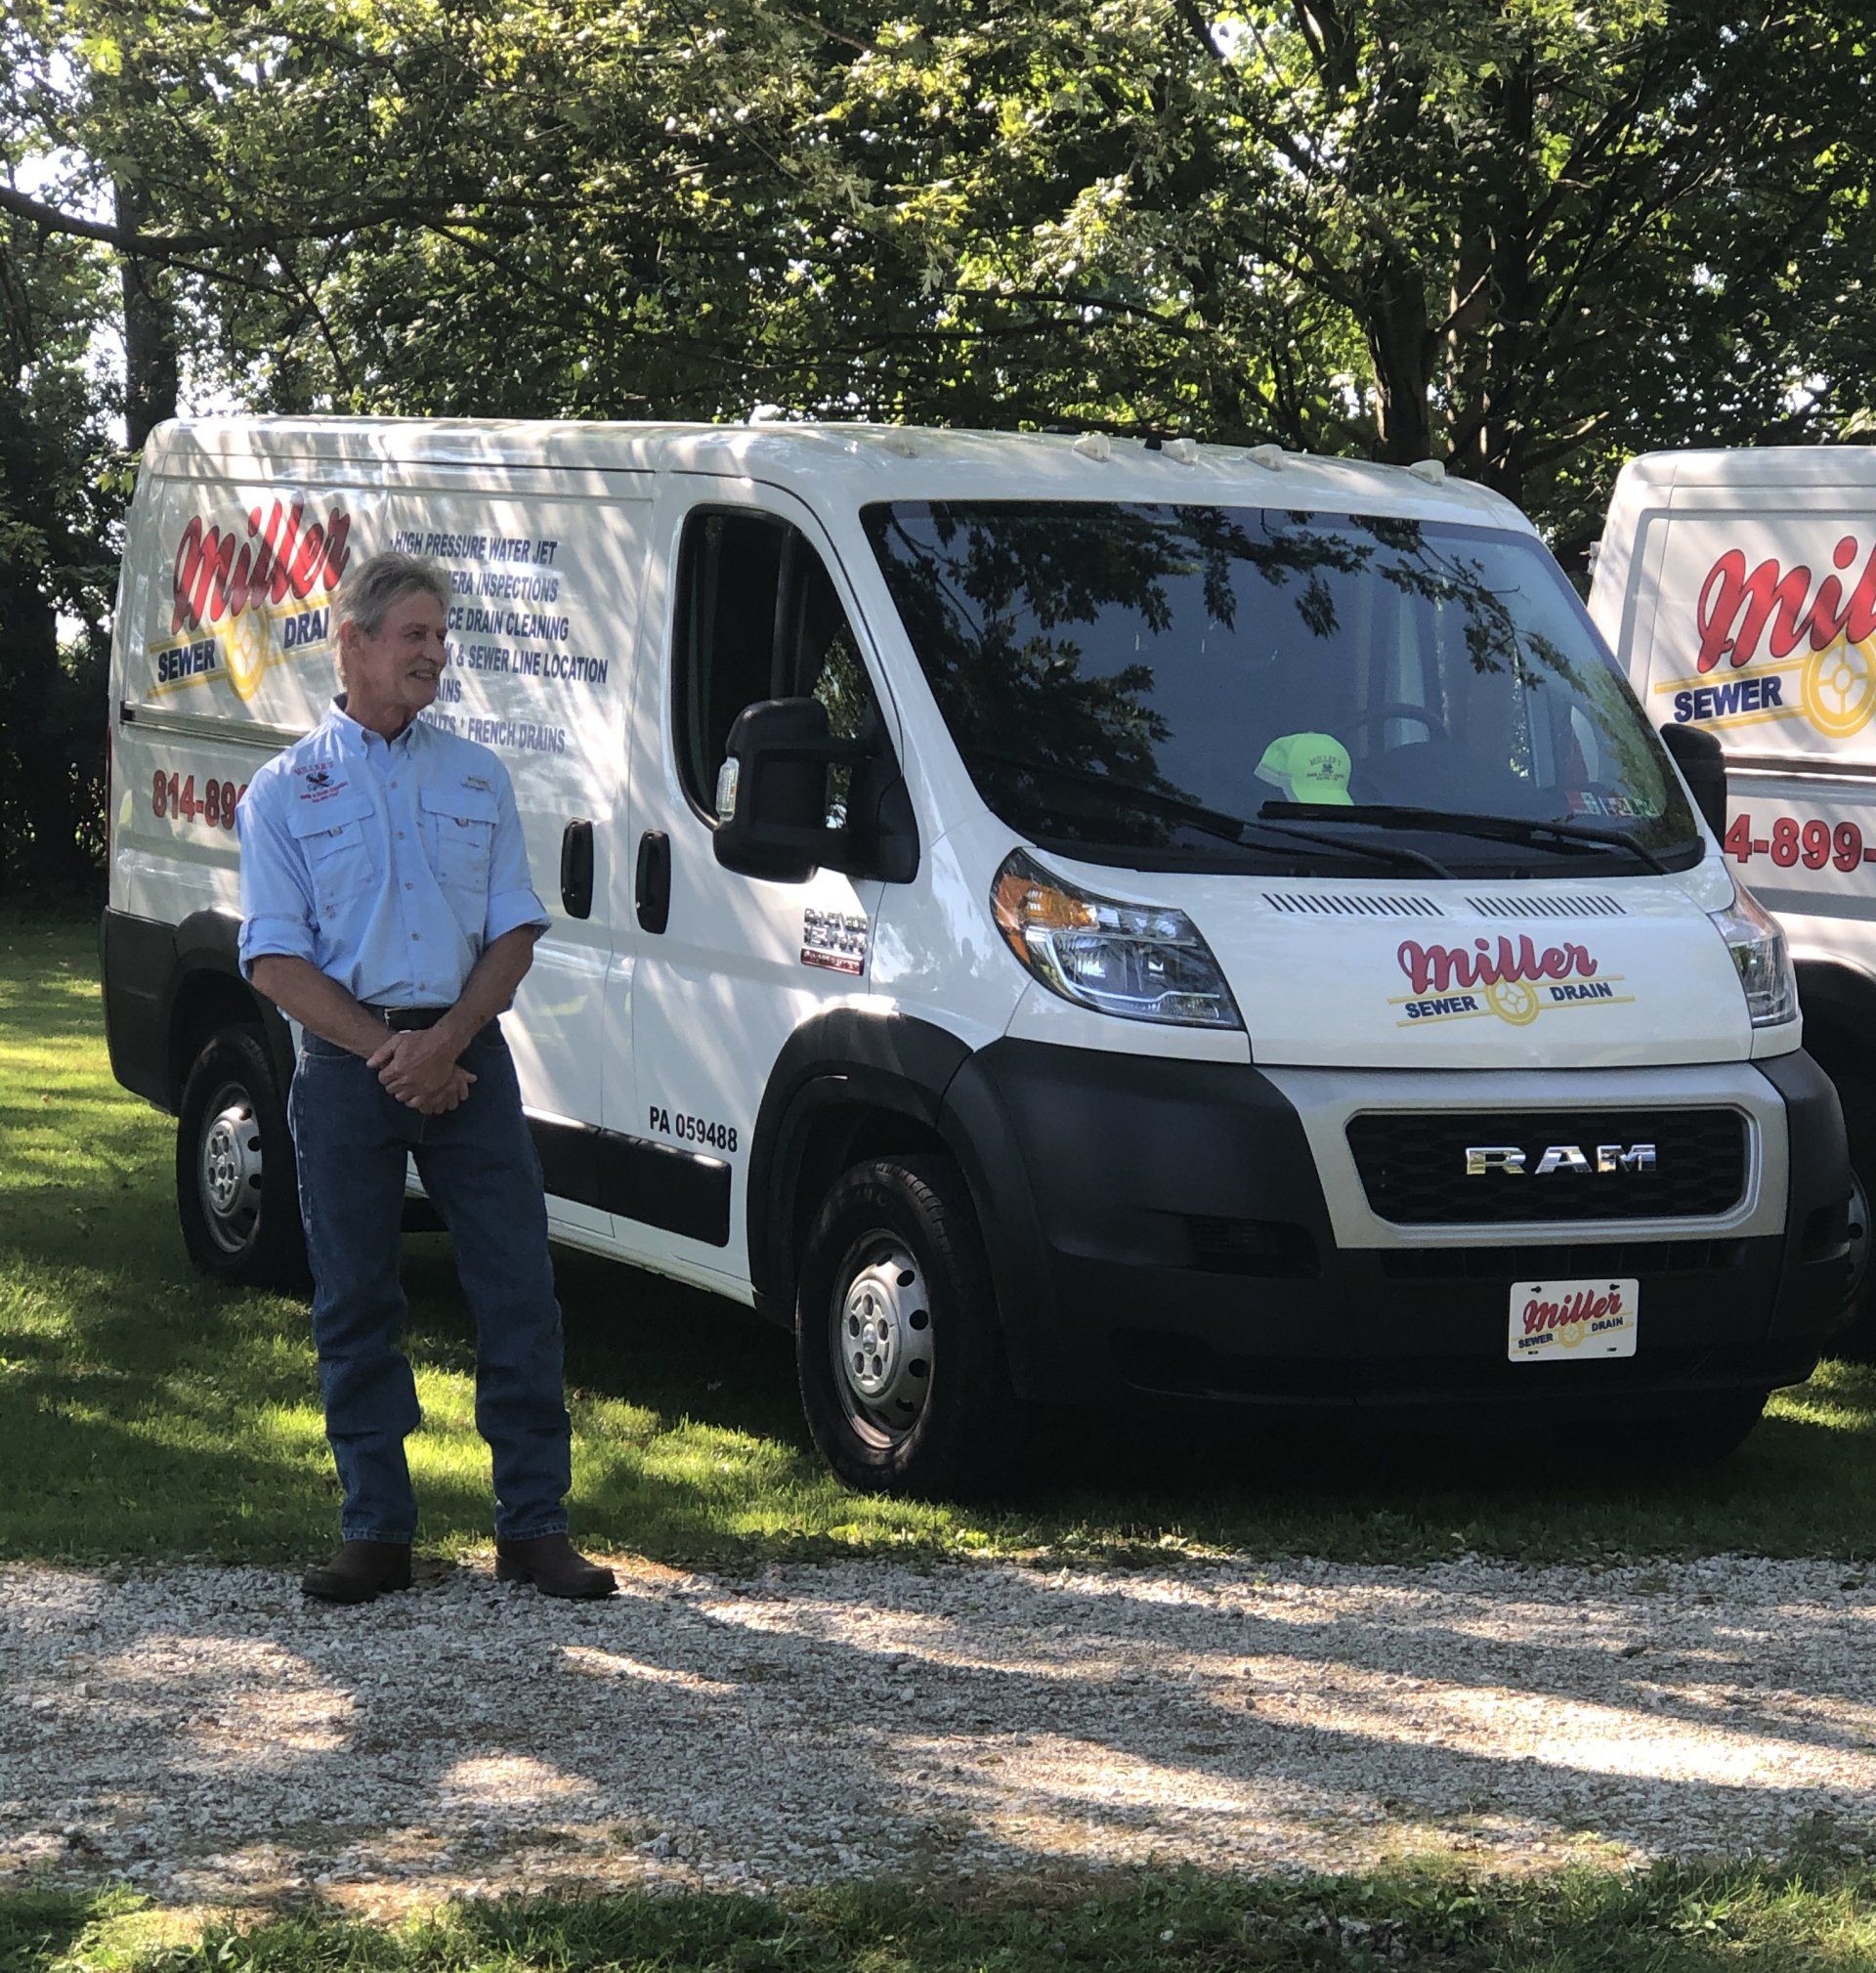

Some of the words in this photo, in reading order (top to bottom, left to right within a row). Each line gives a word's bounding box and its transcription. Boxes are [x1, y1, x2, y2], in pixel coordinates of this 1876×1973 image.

[394, 531, 423, 555] HIGH
[425, 533, 486, 561] PRESSURE
[490, 536, 531, 563] WATER
[532, 540, 558, 565] JET
[476, 572, 559, 603] INSPECTIONS
[465, 608, 503, 635] DRAIN
[506, 612, 570, 641] CLEANING
[158, 638, 216, 682] SEWER
[284, 607, 330, 649] DRAI
[456, 643, 464, 667] &
[468, 645, 509, 672] SEWER
[512, 649, 540, 675] LINE
[543, 653, 608, 684] LOCATION
[436, 677, 461, 704] AINS
[1674, 675, 1783, 723] SEWER
[468, 717, 516, 748] FRENCH
[518, 723, 565, 753] DRAINS
[152, 769, 248, 831] 814-89
[1404, 995, 1478, 1019] SEWER
[1549, 981, 1613, 1002] DRAIN
[649, 1105, 670, 1135] PA
[675, 1113, 738, 1153] 059488
[1466, 1143, 1657, 1176] RAM
[1517, 1332, 1554, 1349] SEWER
[1591, 1316, 1624, 1332] DRAIN
